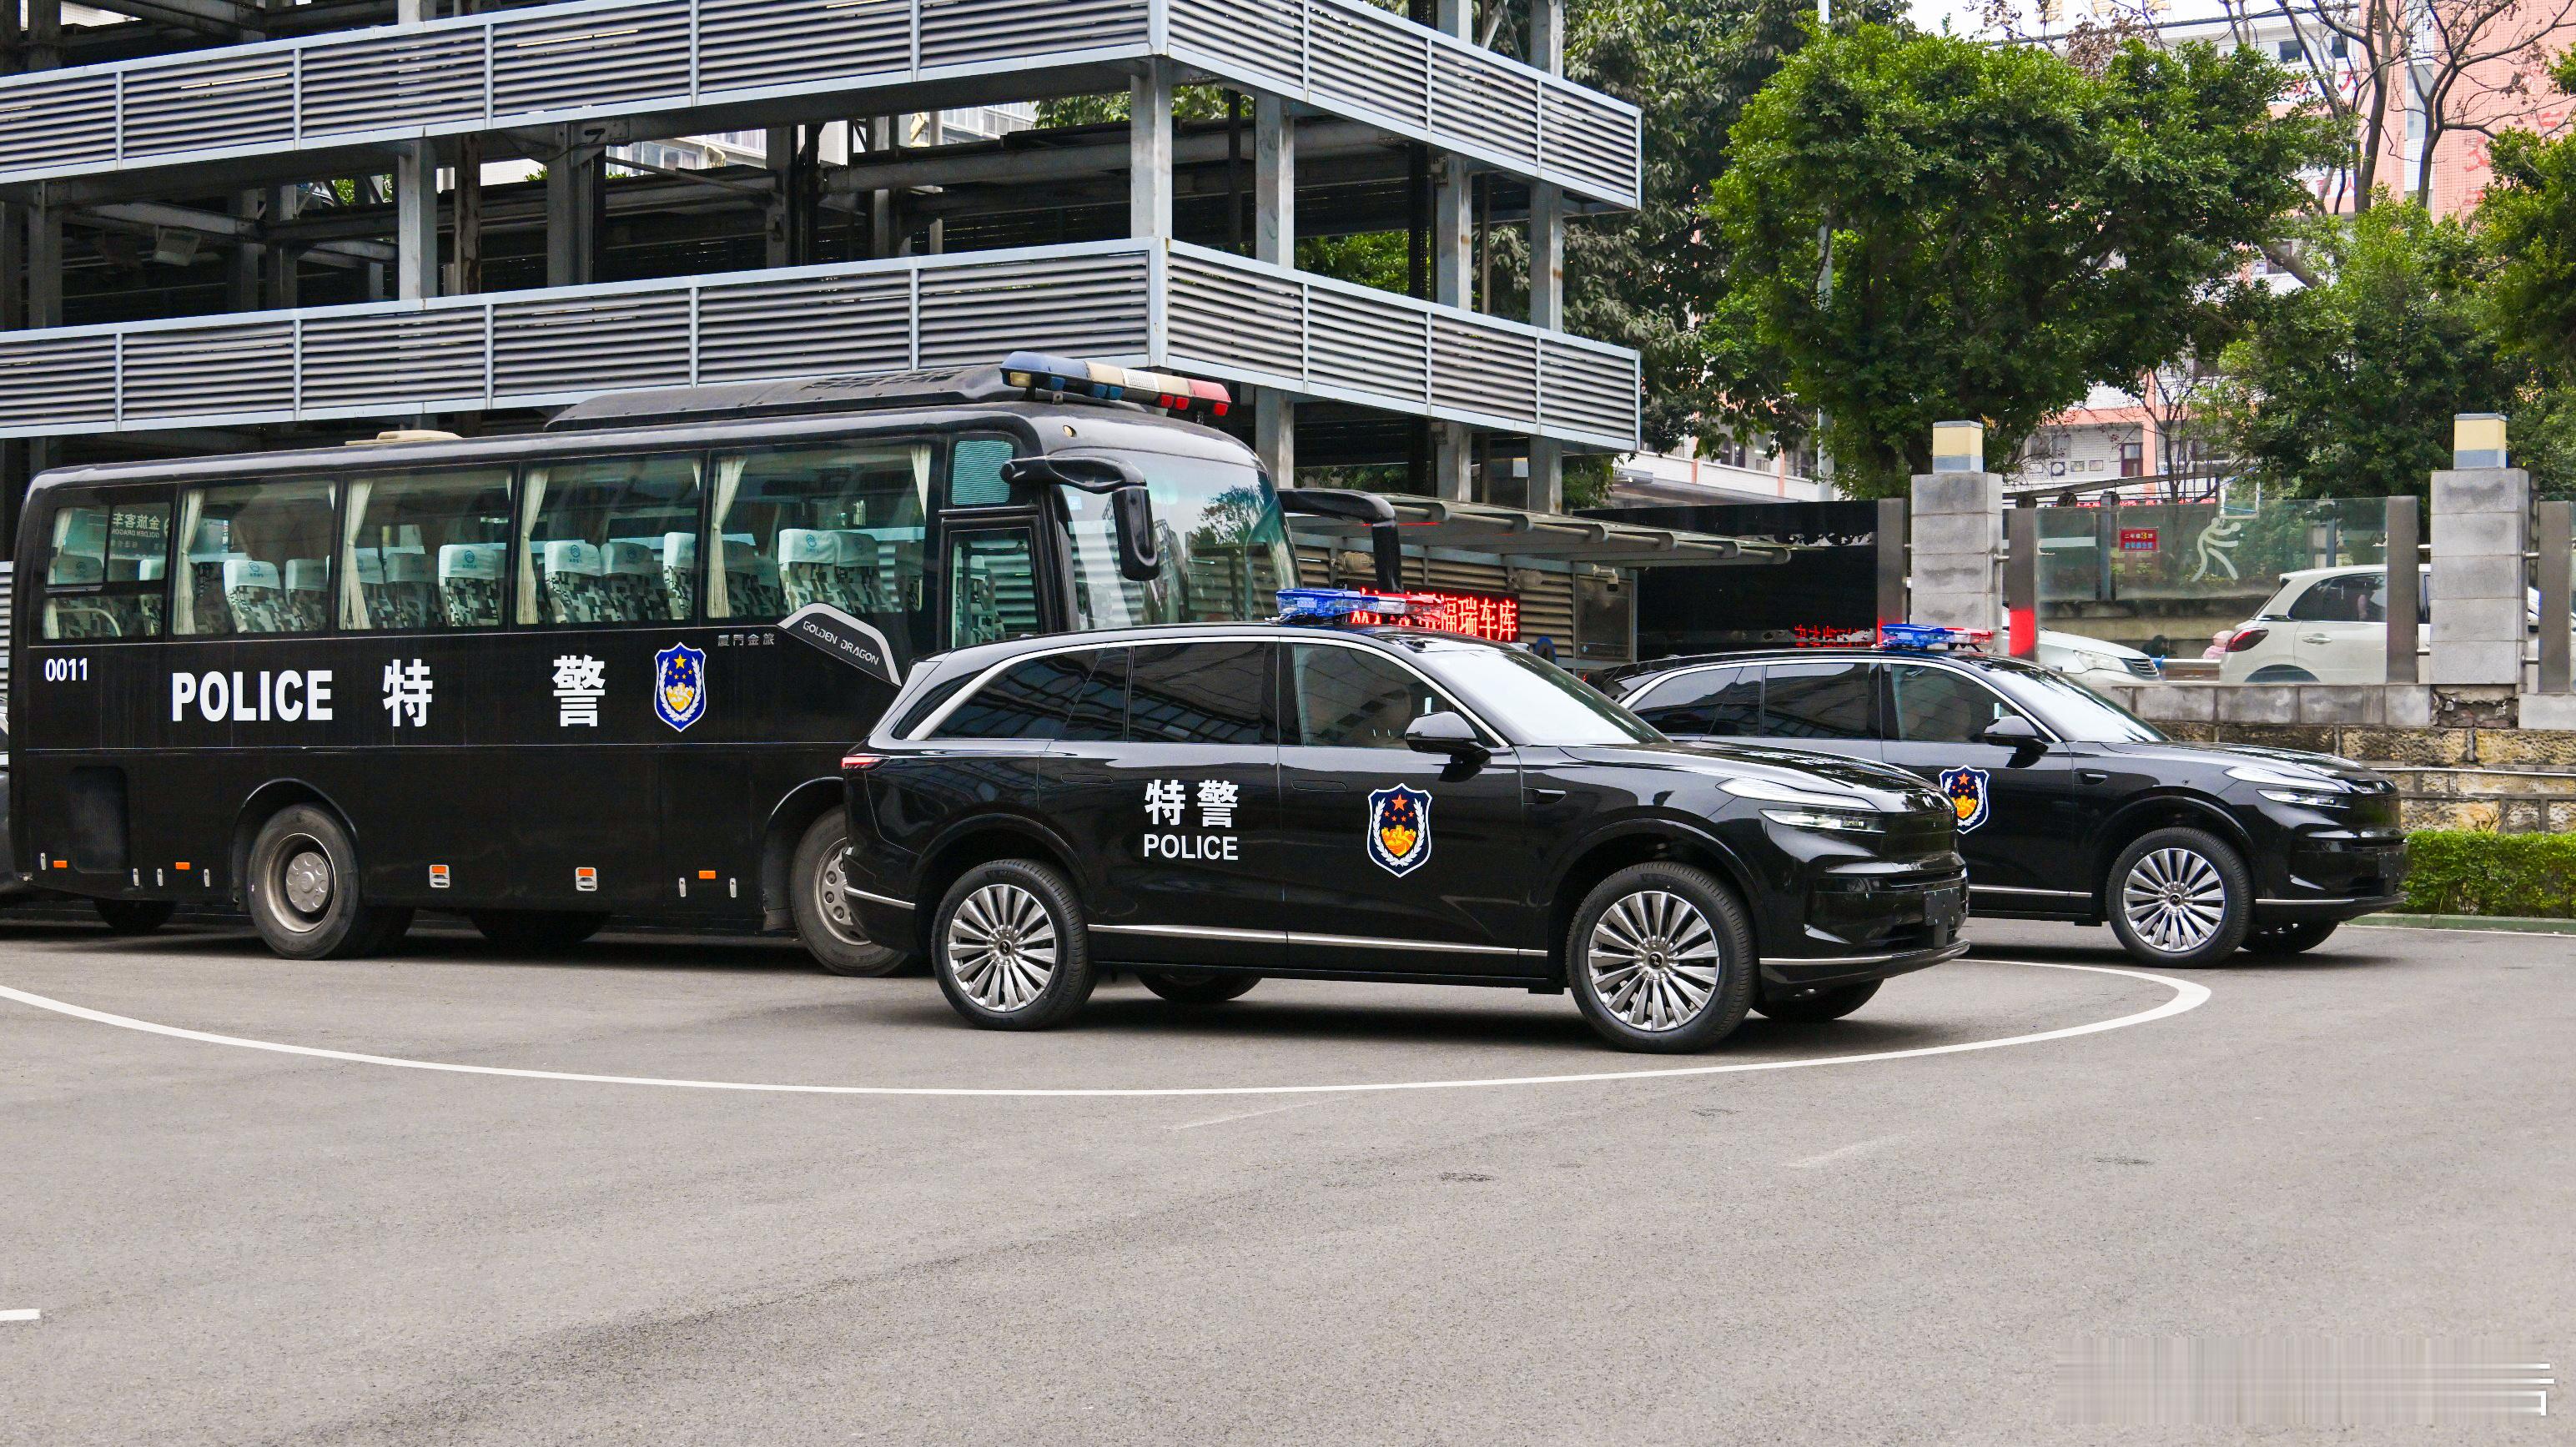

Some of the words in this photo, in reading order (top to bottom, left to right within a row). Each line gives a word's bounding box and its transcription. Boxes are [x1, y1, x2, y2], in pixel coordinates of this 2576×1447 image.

[802, 621, 838, 645] GOLDEN
[840, 639, 879, 666] DRAGON
[45, 657, 88, 681] 0011
[172, 670, 333, 722] POLICE
[1144, 779, 1239, 828] 特警
[1144, 833, 1239, 861] POLICE
